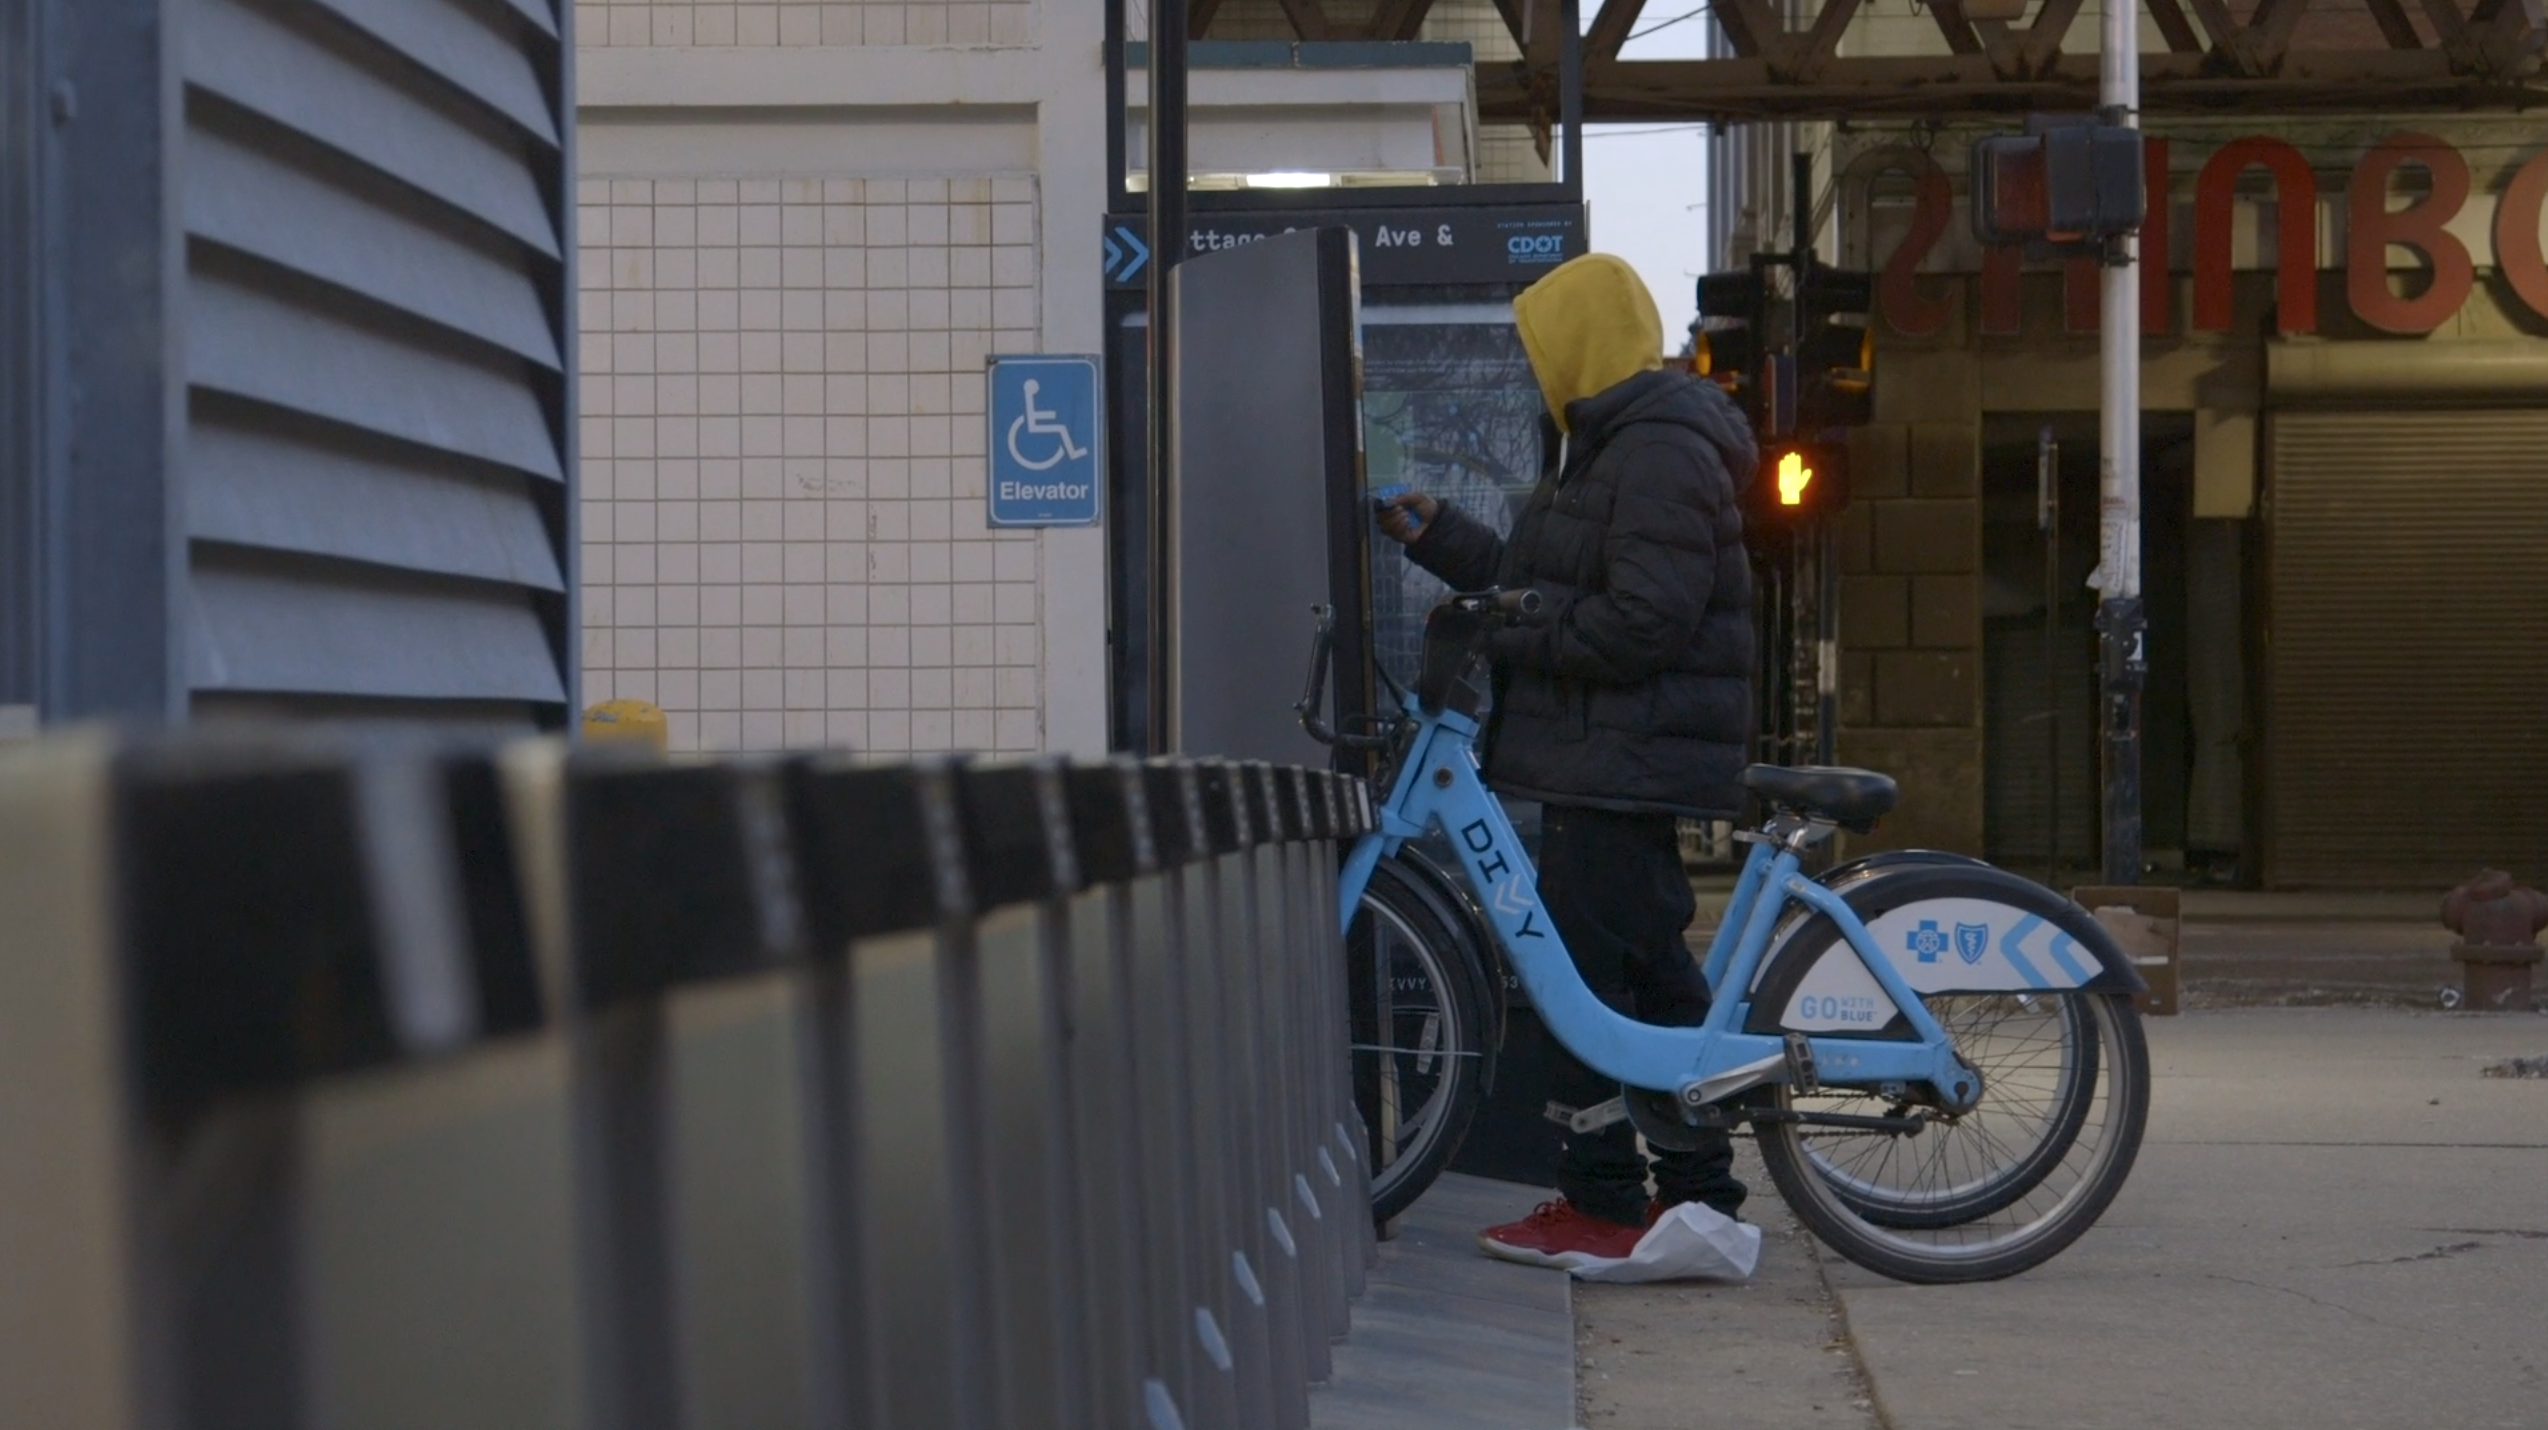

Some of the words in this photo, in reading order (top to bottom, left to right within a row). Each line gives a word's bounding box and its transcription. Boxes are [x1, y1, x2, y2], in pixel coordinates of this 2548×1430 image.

[1375, 225, 1421, 247] Ave
[1437, 225, 1454, 246] &
[1508, 235, 1563, 253] CDOT
[1000, 481, 1089, 500] Elevator
[1801, 995, 1837, 1020] GO
[1841, 996, 1874, 1008] WITH
